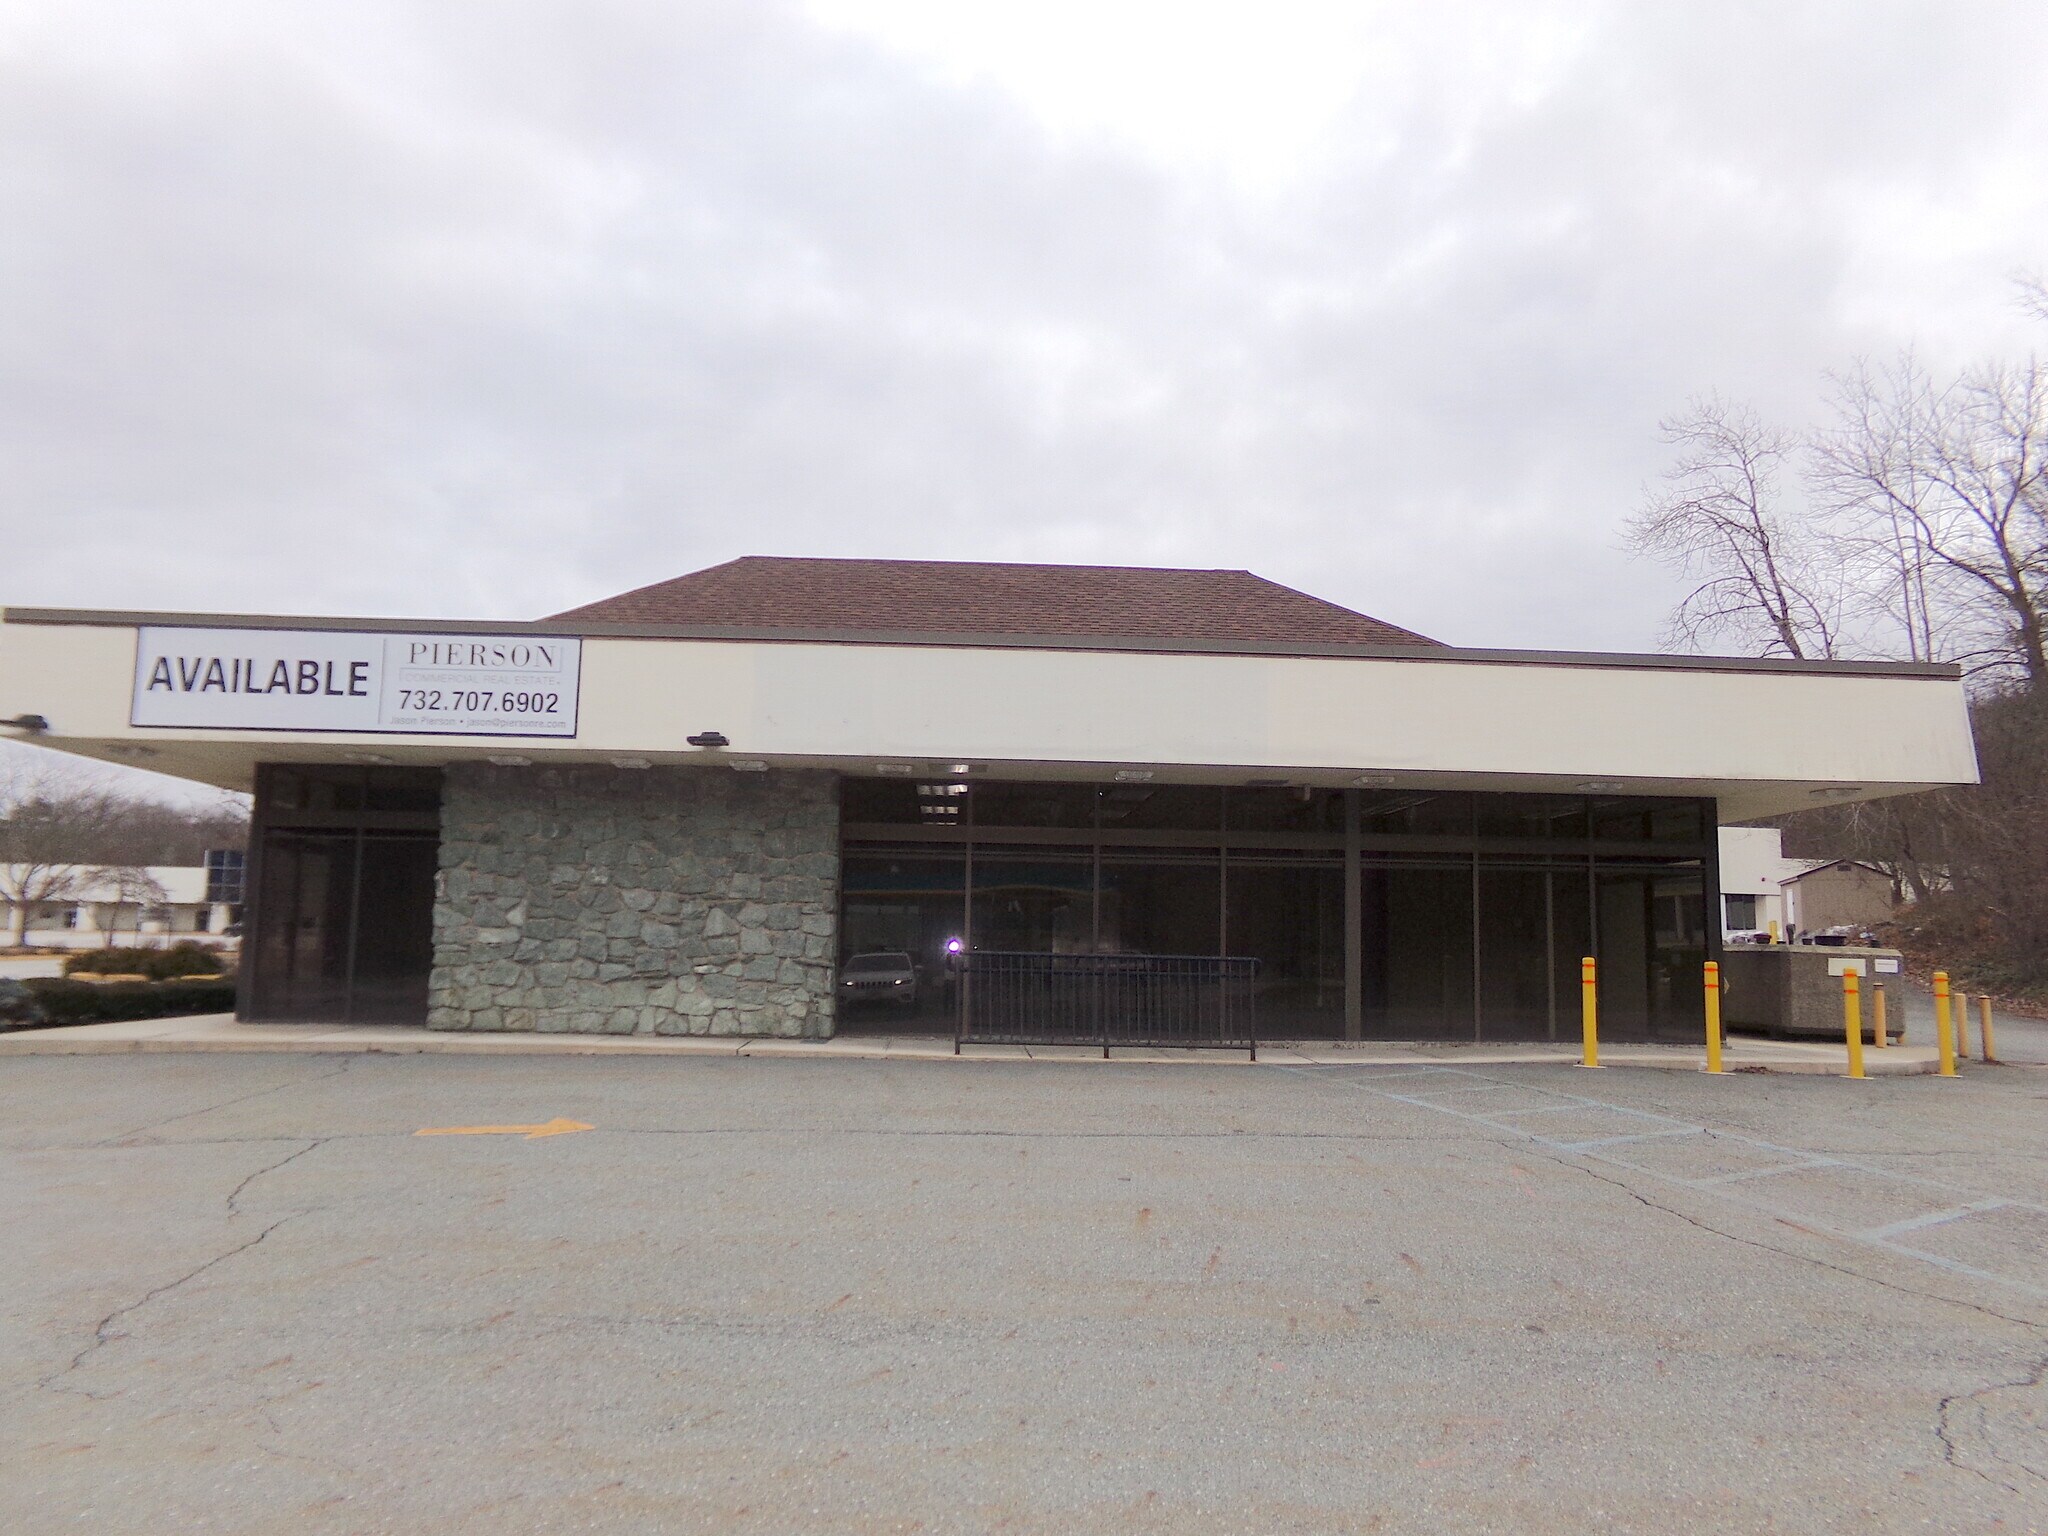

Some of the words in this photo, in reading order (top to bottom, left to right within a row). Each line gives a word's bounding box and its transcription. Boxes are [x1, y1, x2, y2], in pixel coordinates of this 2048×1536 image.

[408, 642, 557, 667] PIERSON
[147, 656, 369, 696] AVAILABLE
[405, 673, 479, 685] COMMERCIAL
[483, 674, 511, 685] REAL
[399, 690, 559, 713] 732.707.6902
[390, 715, 417, 726] Jason
[420, 716, 456, 727] Pierson
